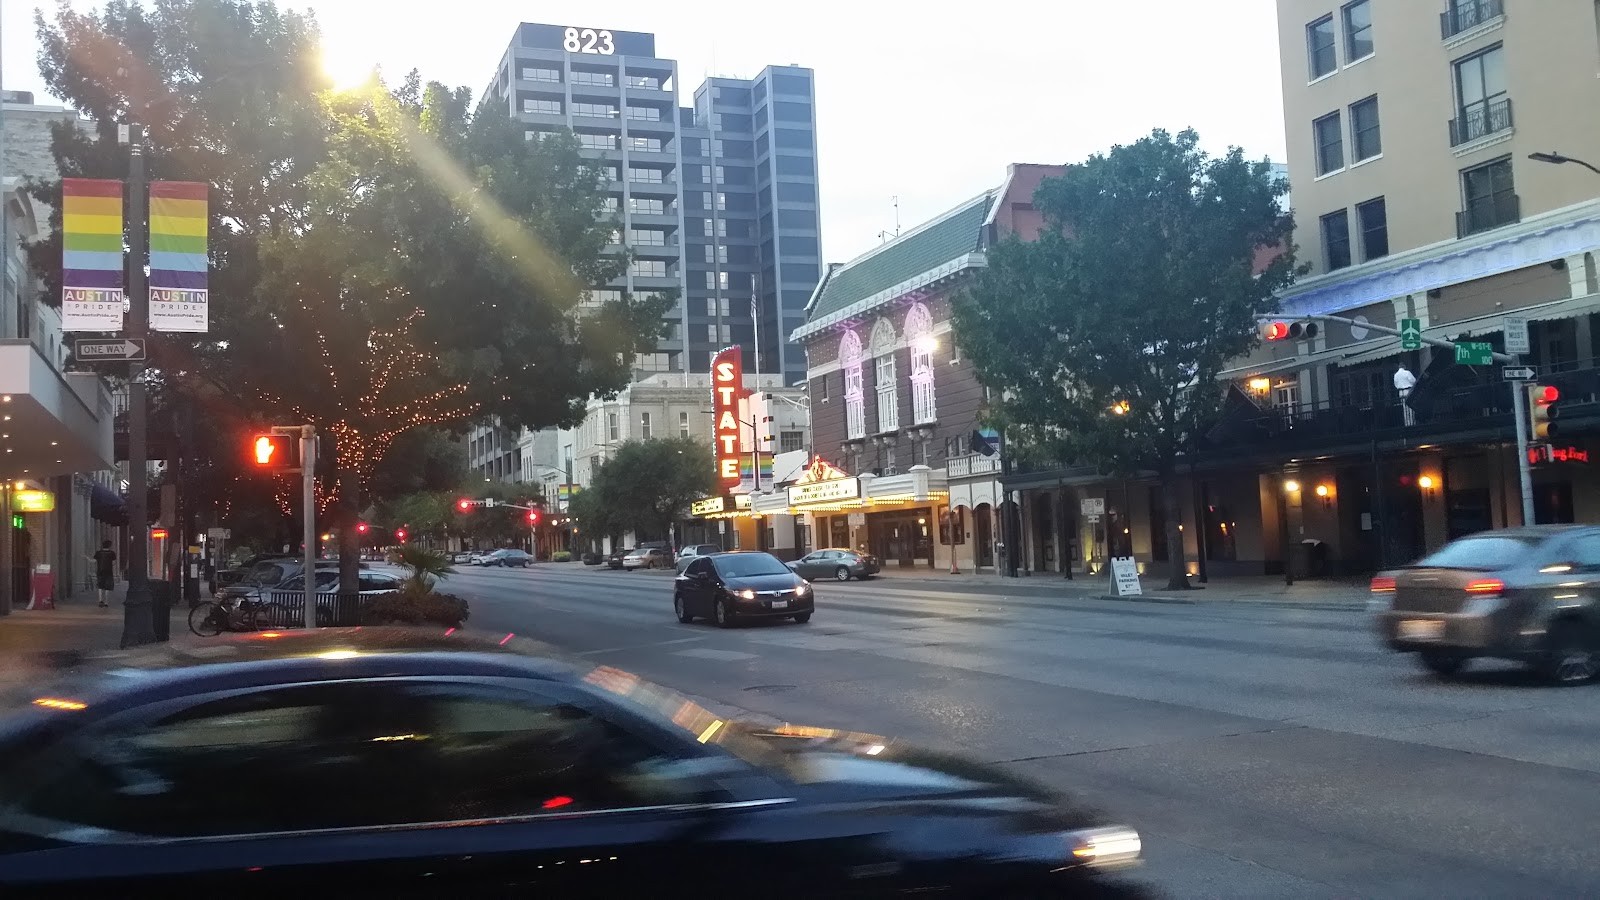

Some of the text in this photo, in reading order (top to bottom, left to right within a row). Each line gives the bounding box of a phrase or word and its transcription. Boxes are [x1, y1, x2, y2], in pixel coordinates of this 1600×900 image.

[563, 27, 615, 56] 823
[65, 290, 121, 302] AUSTIN
[151, 290, 206, 303] AUSTIN
[84, 345, 126, 354] ONE WAY
[1455, 344, 1470, 361] 7th
[717, 362, 739, 478] STATE
